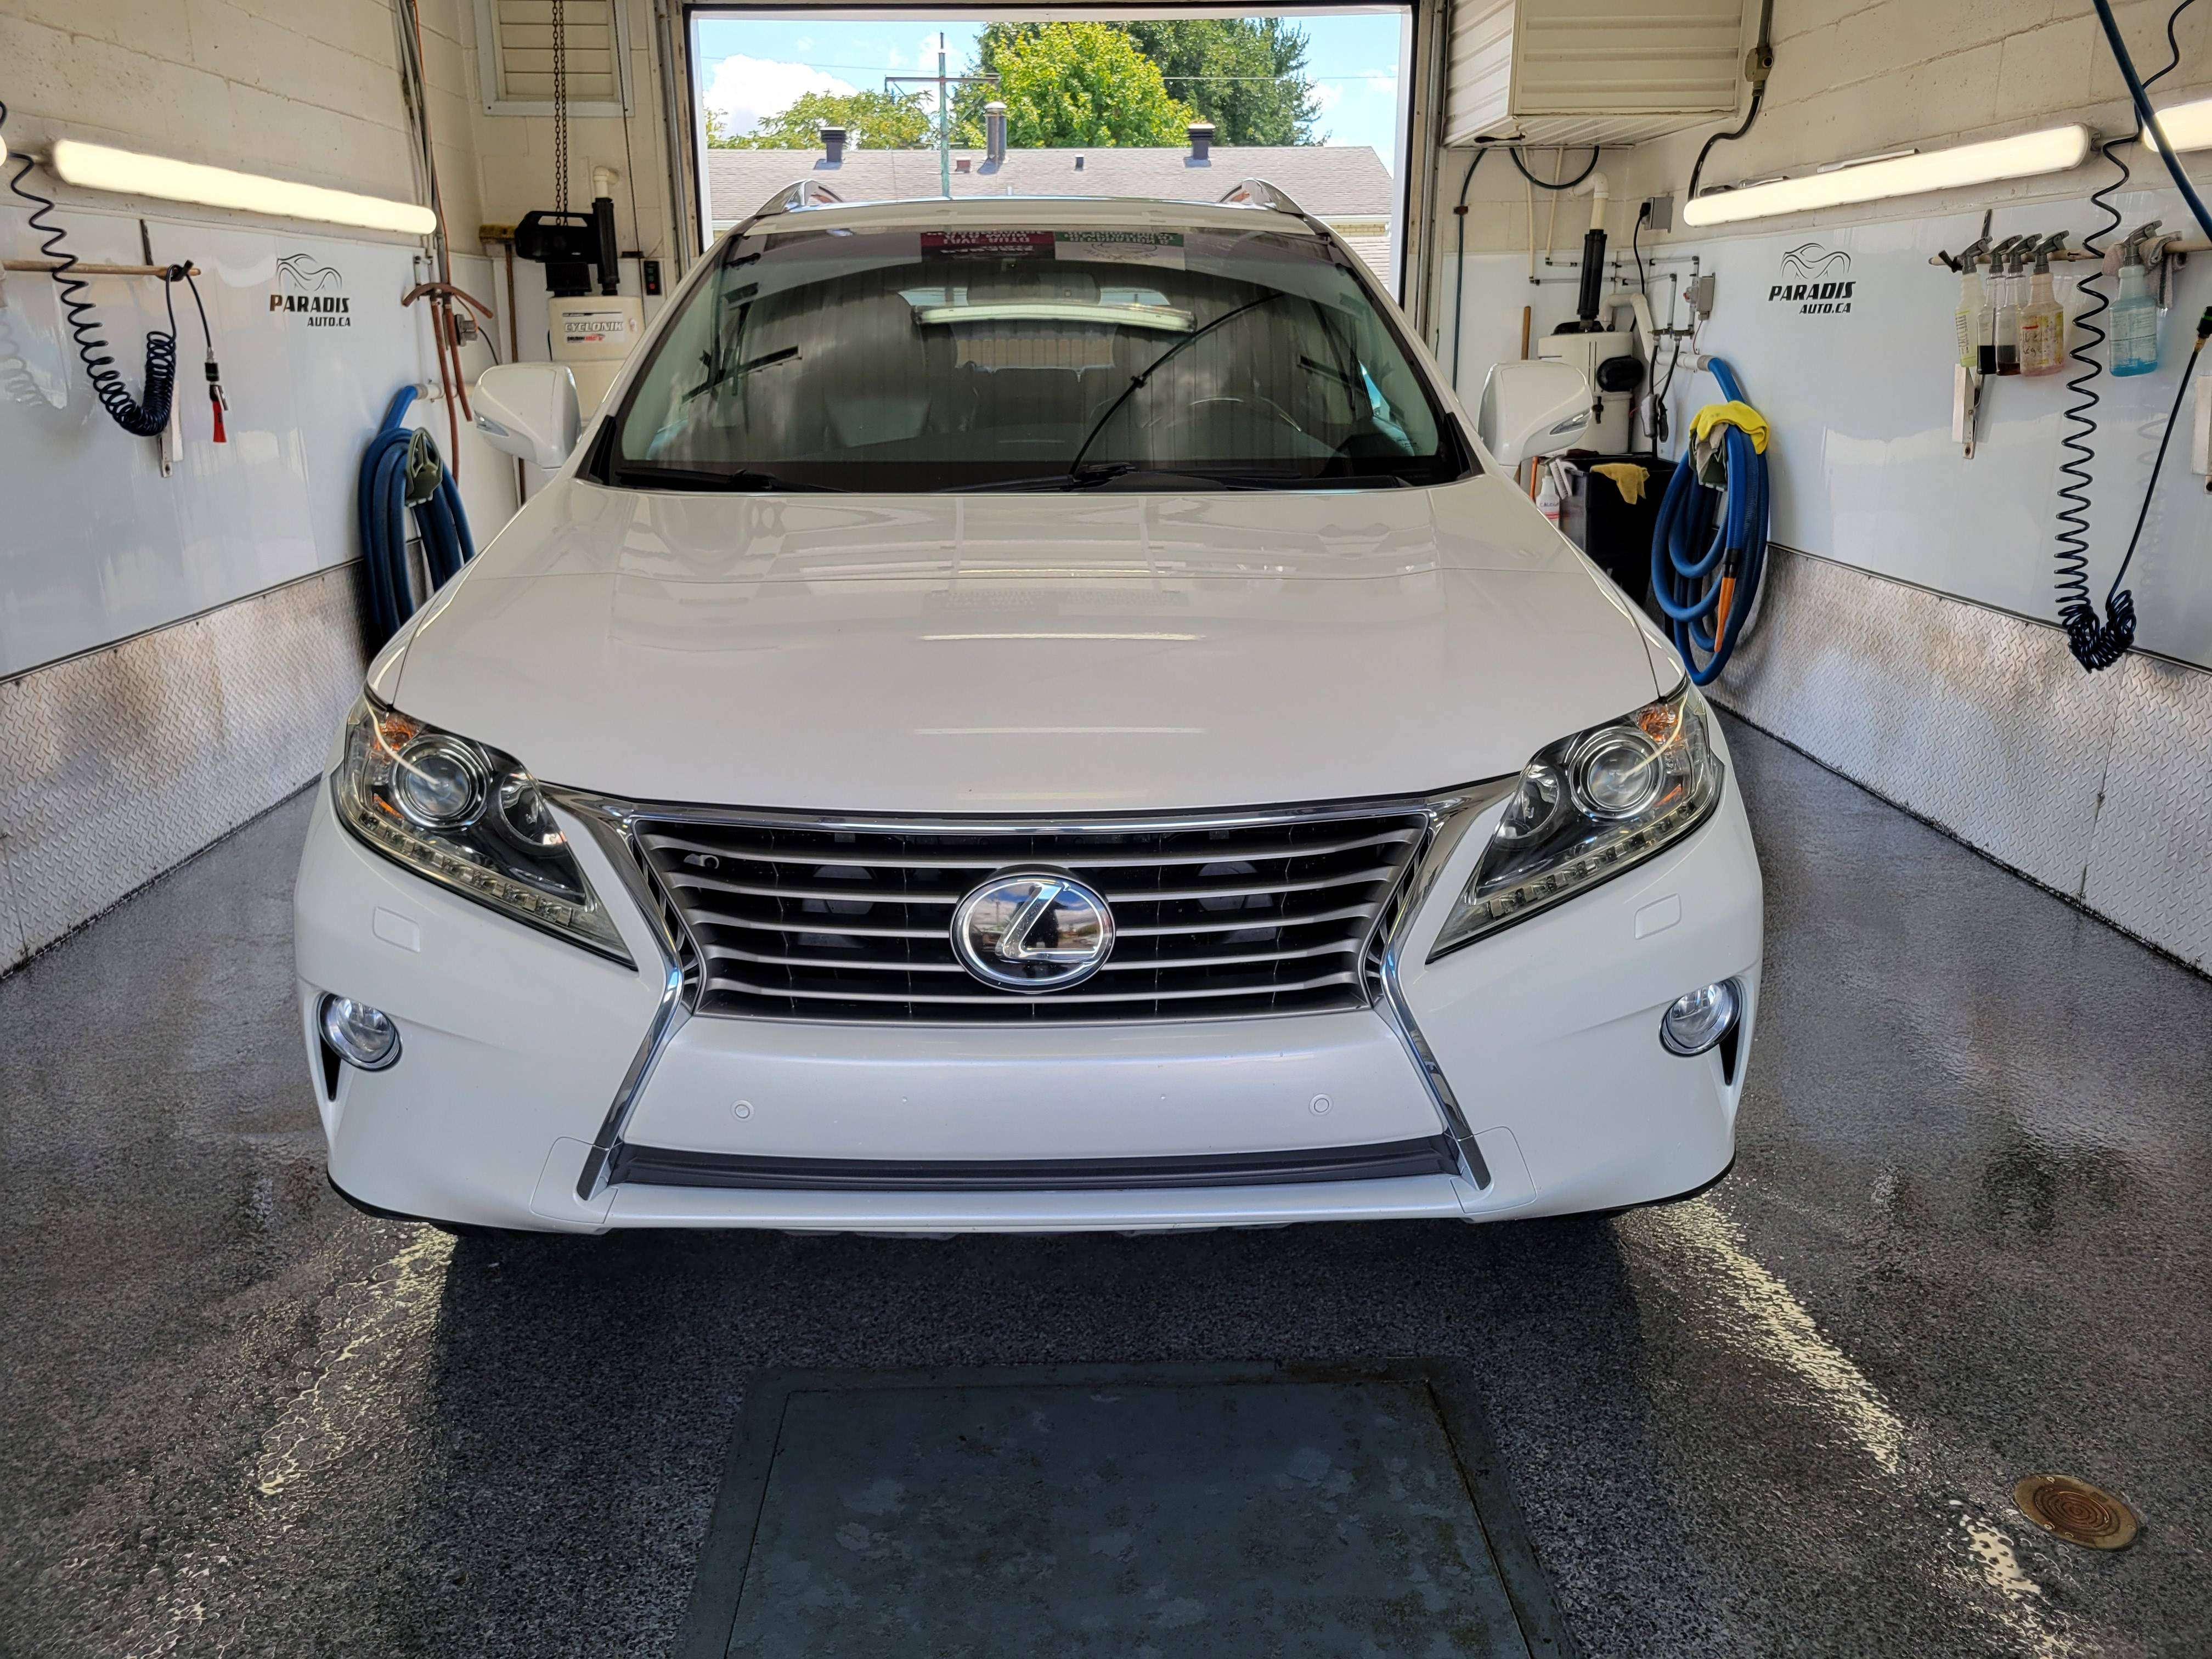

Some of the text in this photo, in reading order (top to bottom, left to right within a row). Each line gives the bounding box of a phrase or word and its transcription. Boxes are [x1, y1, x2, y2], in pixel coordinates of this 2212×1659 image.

[1768, 281, 1857, 301] PARADIS
[270, 295, 349, 313] PARADIS
[1799, 303, 1852, 314] AUTO.CA
[308, 317, 350, 326] AUTO.CA
[565, 321, 623, 332] CYCLONIK
